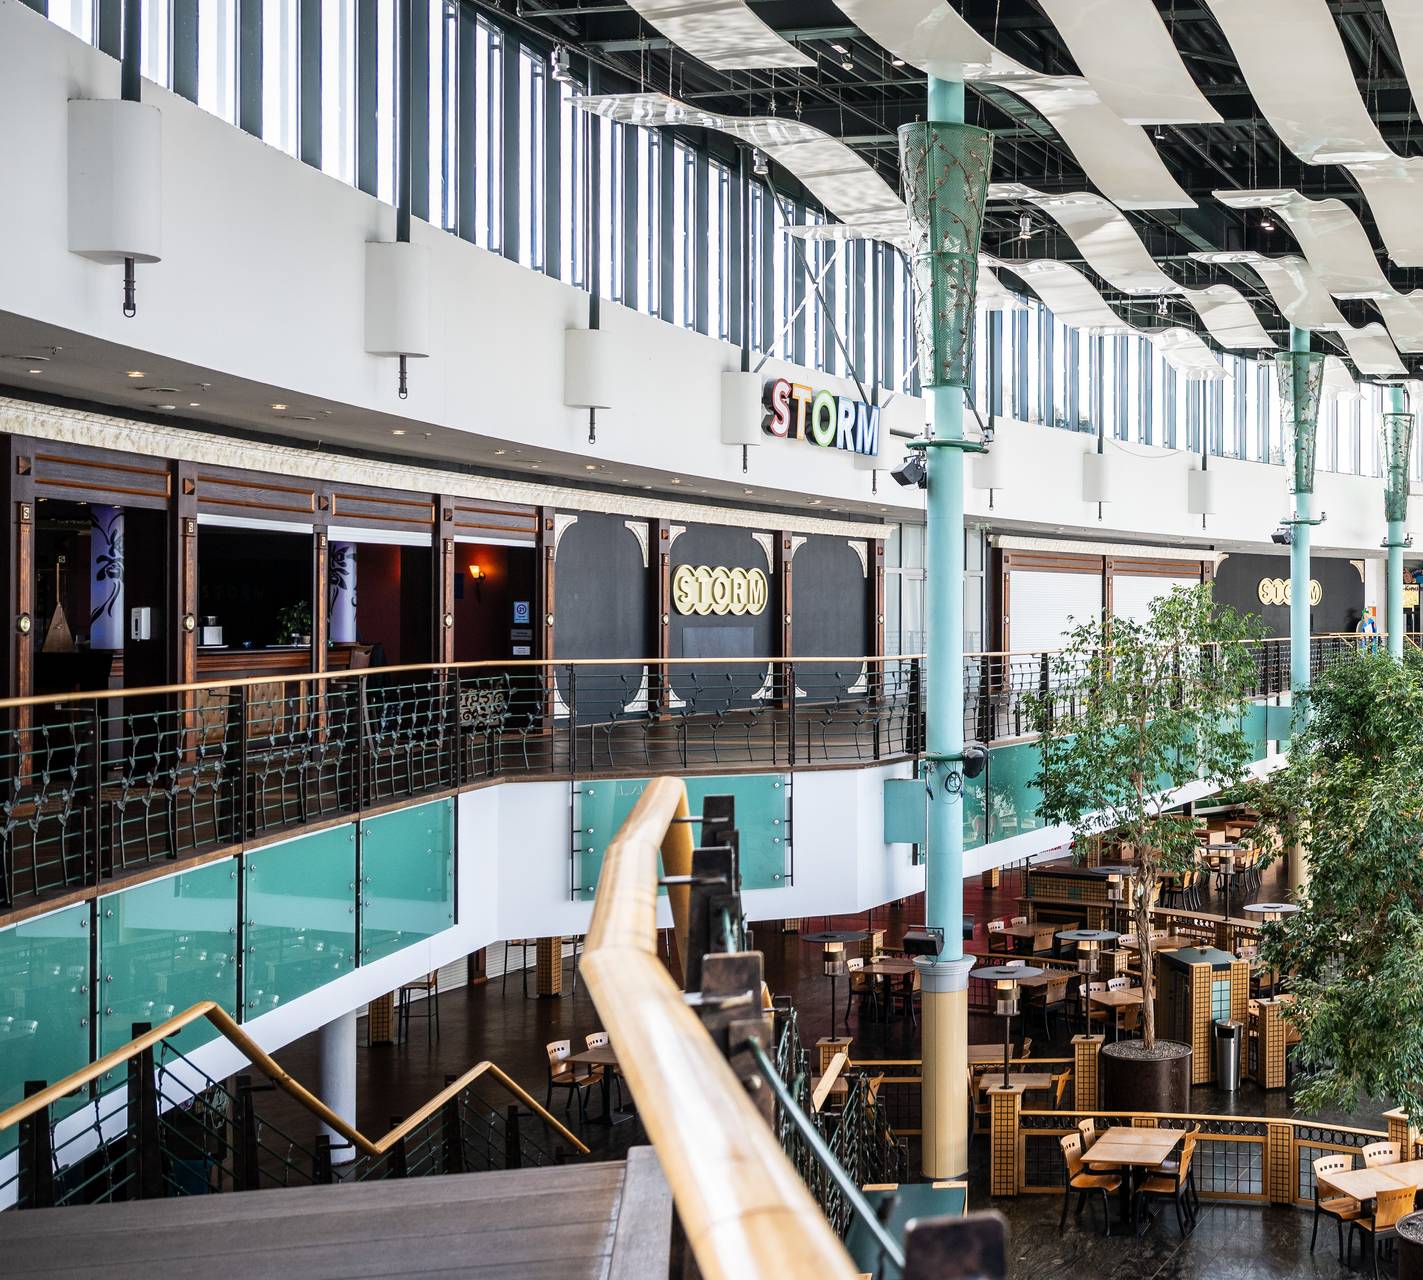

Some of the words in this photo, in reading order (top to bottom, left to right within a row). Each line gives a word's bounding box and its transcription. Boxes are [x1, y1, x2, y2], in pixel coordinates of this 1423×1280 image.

[764, 377, 881, 457] STORM
[676, 572, 766, 609] STORM
[1260, 582, 1320, 602] STOM
